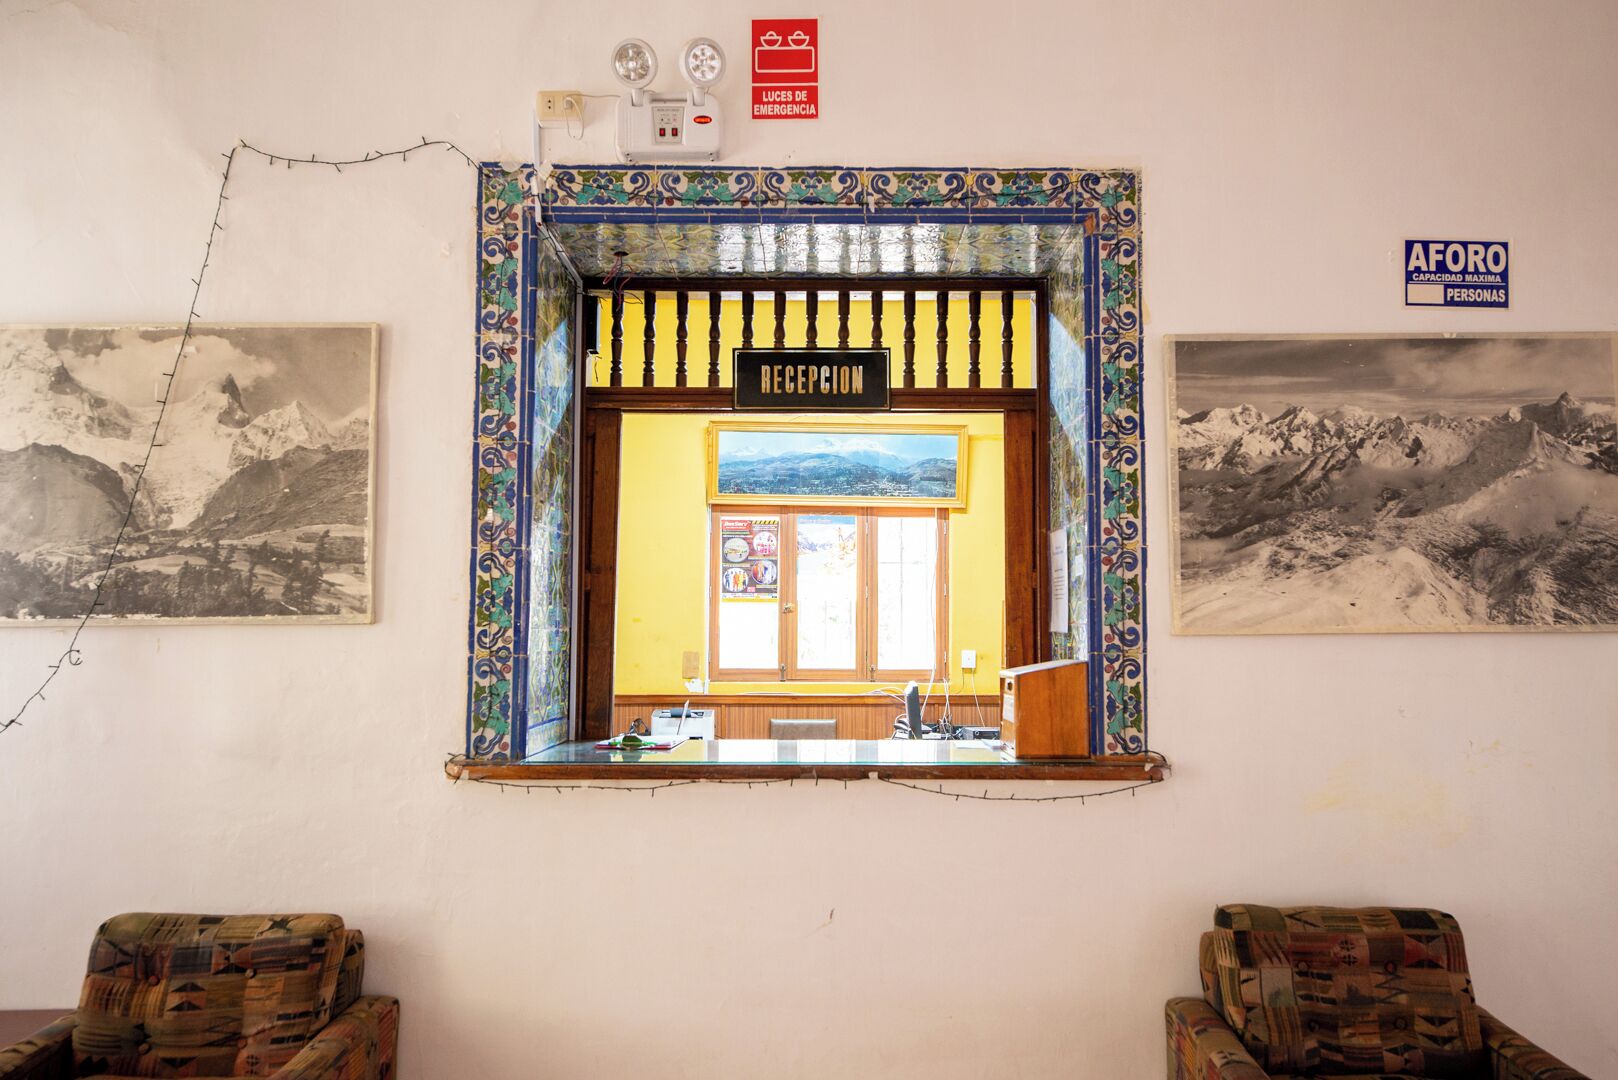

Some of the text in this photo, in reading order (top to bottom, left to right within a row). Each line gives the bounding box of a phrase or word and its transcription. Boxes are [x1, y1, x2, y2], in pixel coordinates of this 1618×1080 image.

[762, 91, 808, 102] LUCES DE
[753, 104, 817, 116] EMERGENCIA
[1407, 243, 1507, 273] AFORO
[1412, 273, 1502, 283] CAPACIDAD MAXIMA
[1447, 288, 1506, 303] PERSONAS
[761, 365, 863, 395] RECEPCION
